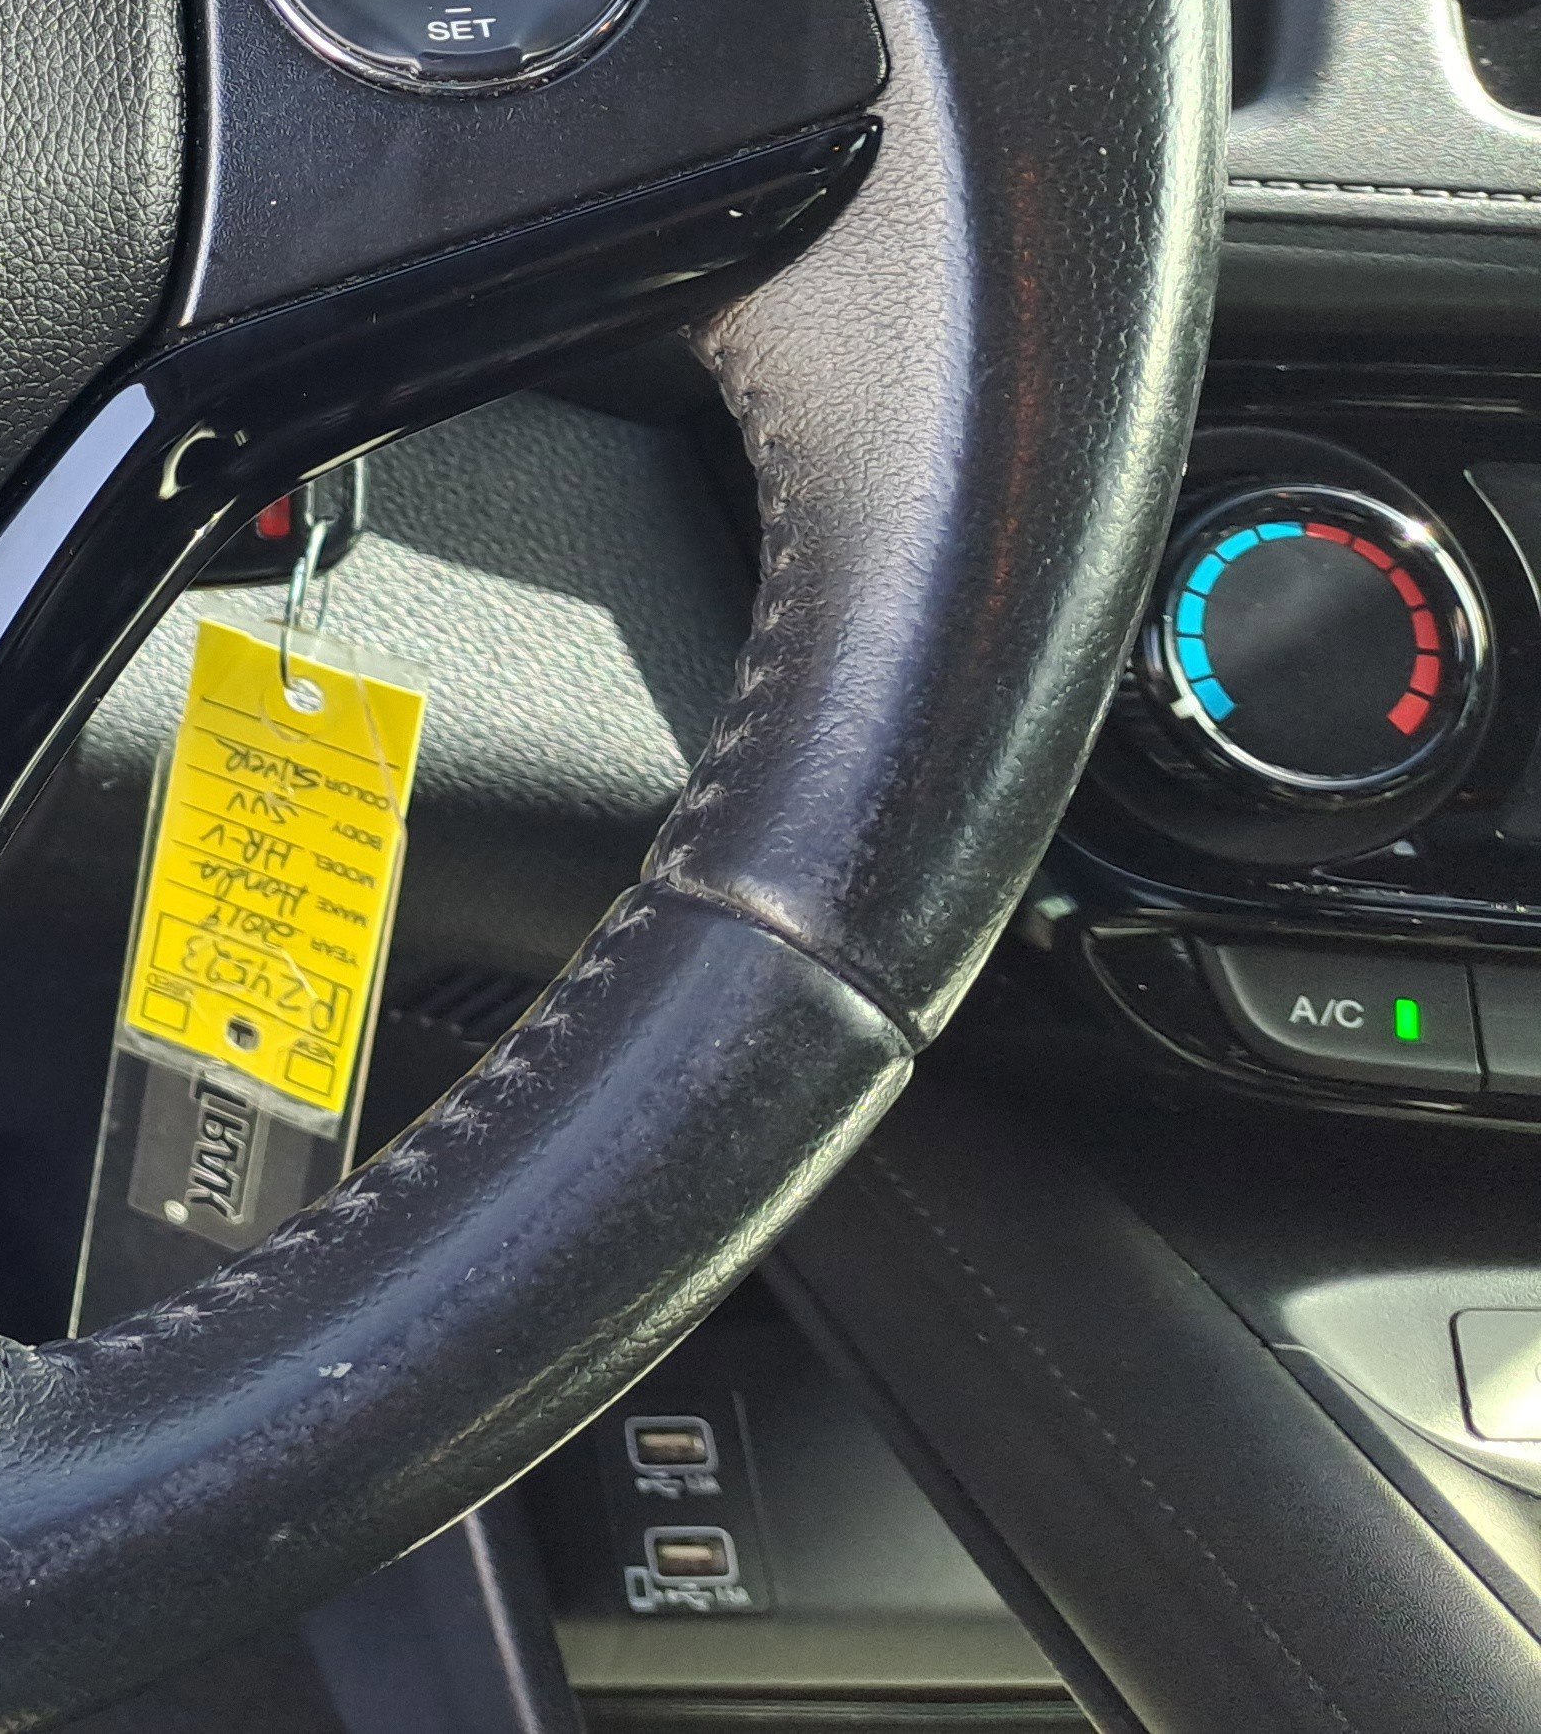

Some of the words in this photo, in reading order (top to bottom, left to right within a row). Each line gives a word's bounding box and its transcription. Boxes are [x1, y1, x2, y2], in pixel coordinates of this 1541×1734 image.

[428, 18, 496, 41] SET
[325, 777, 390, 810] COLOR
[200, 824, 296, 870] HR-V
[331, 821, 383, 851] BODY
[312, 852, 376, 888] MODEL
[1289, 995, 1364, 1029] A/C
